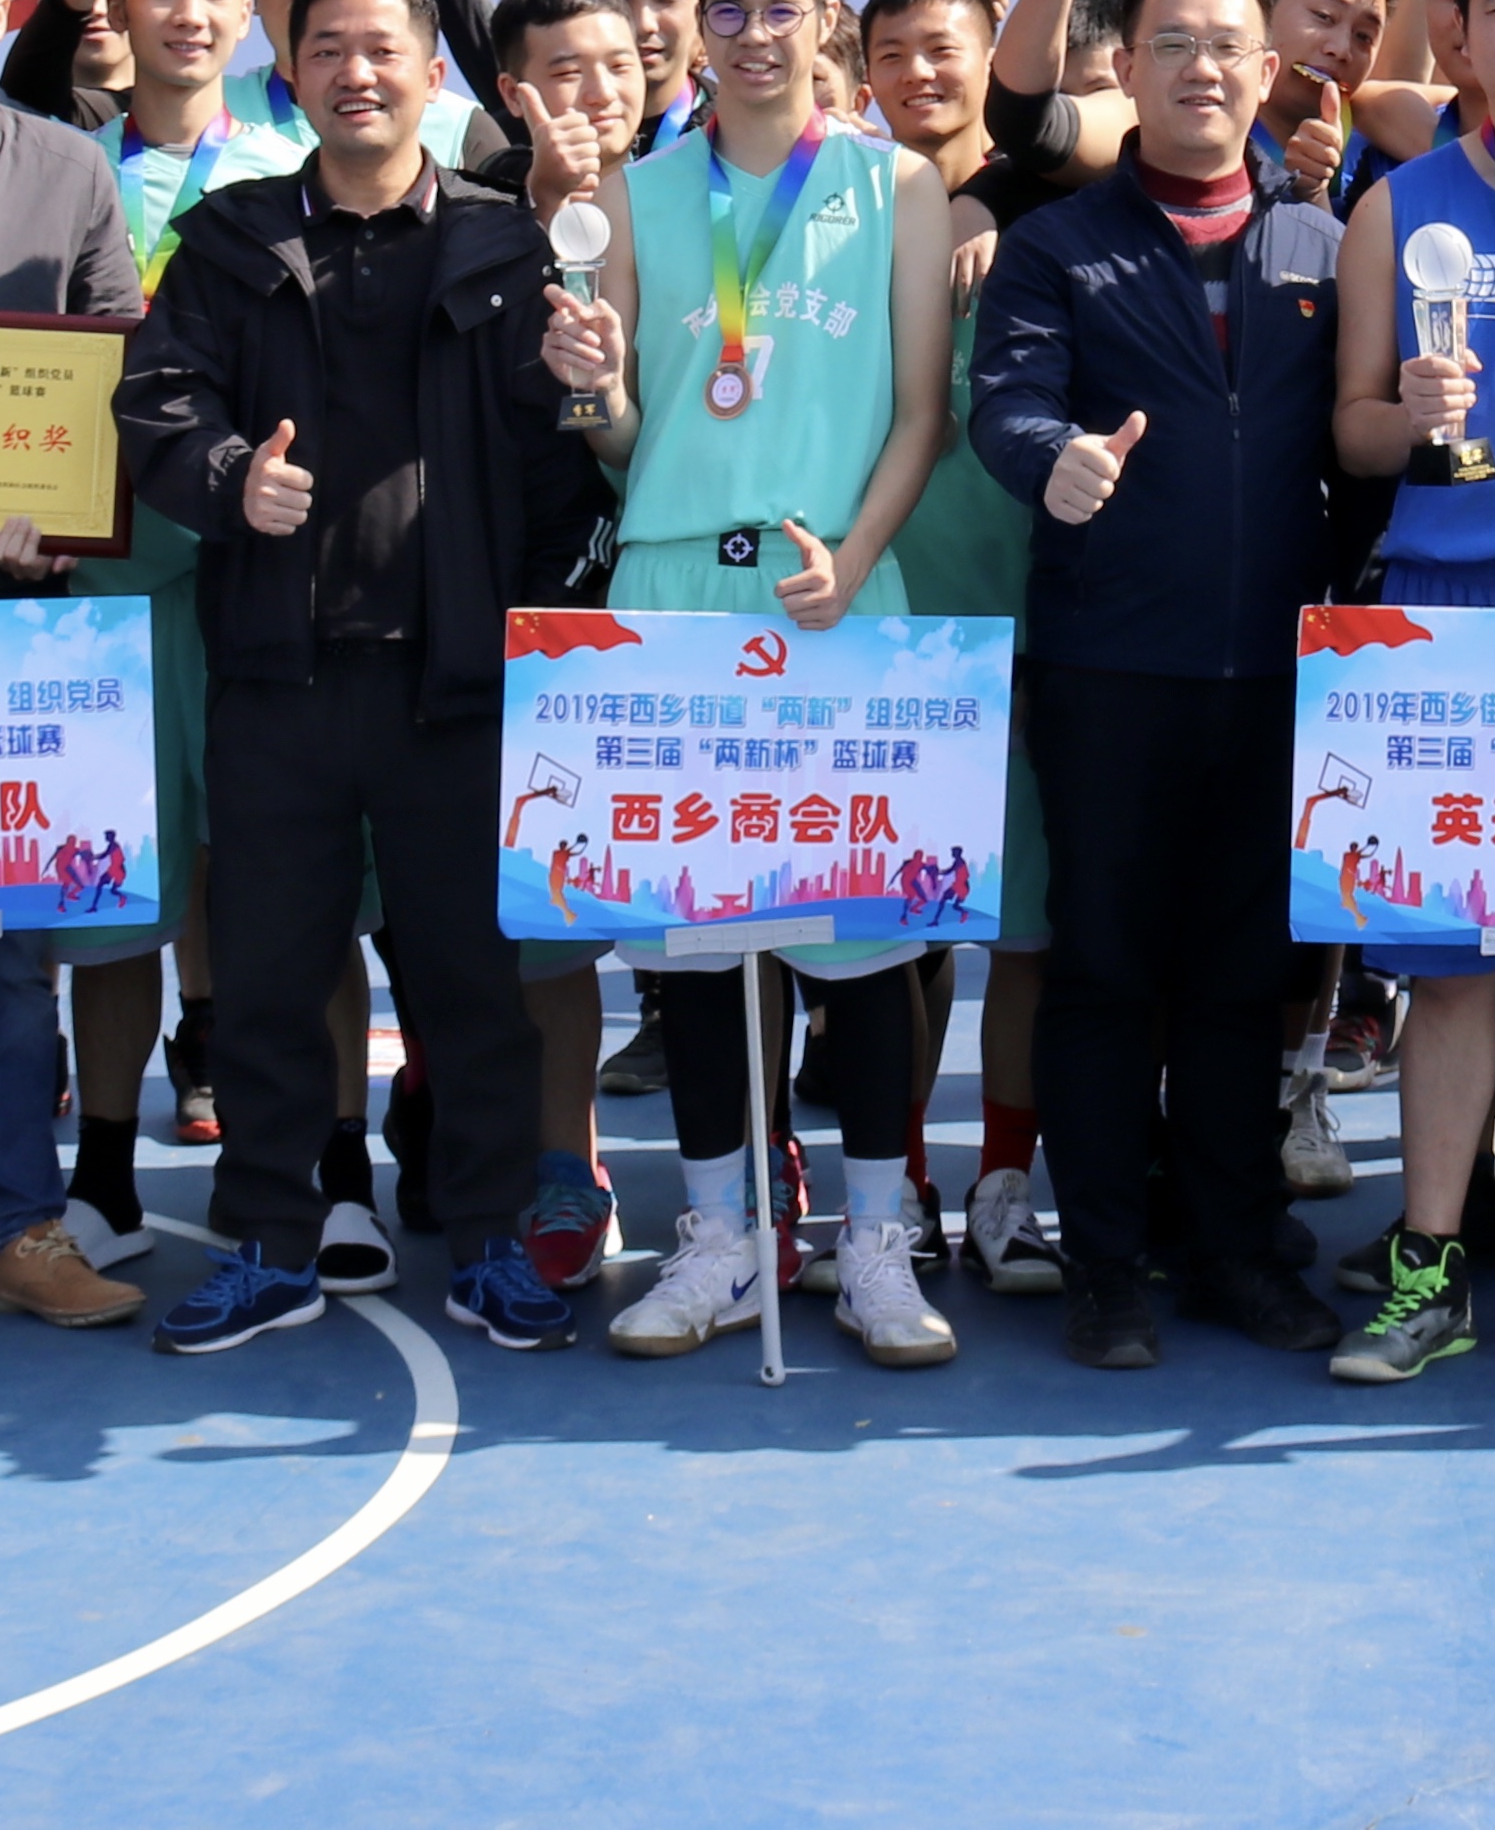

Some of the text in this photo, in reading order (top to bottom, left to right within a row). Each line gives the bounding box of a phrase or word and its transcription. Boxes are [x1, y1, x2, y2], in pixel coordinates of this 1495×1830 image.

[610, 791, 899, 846] 西乡商会队
